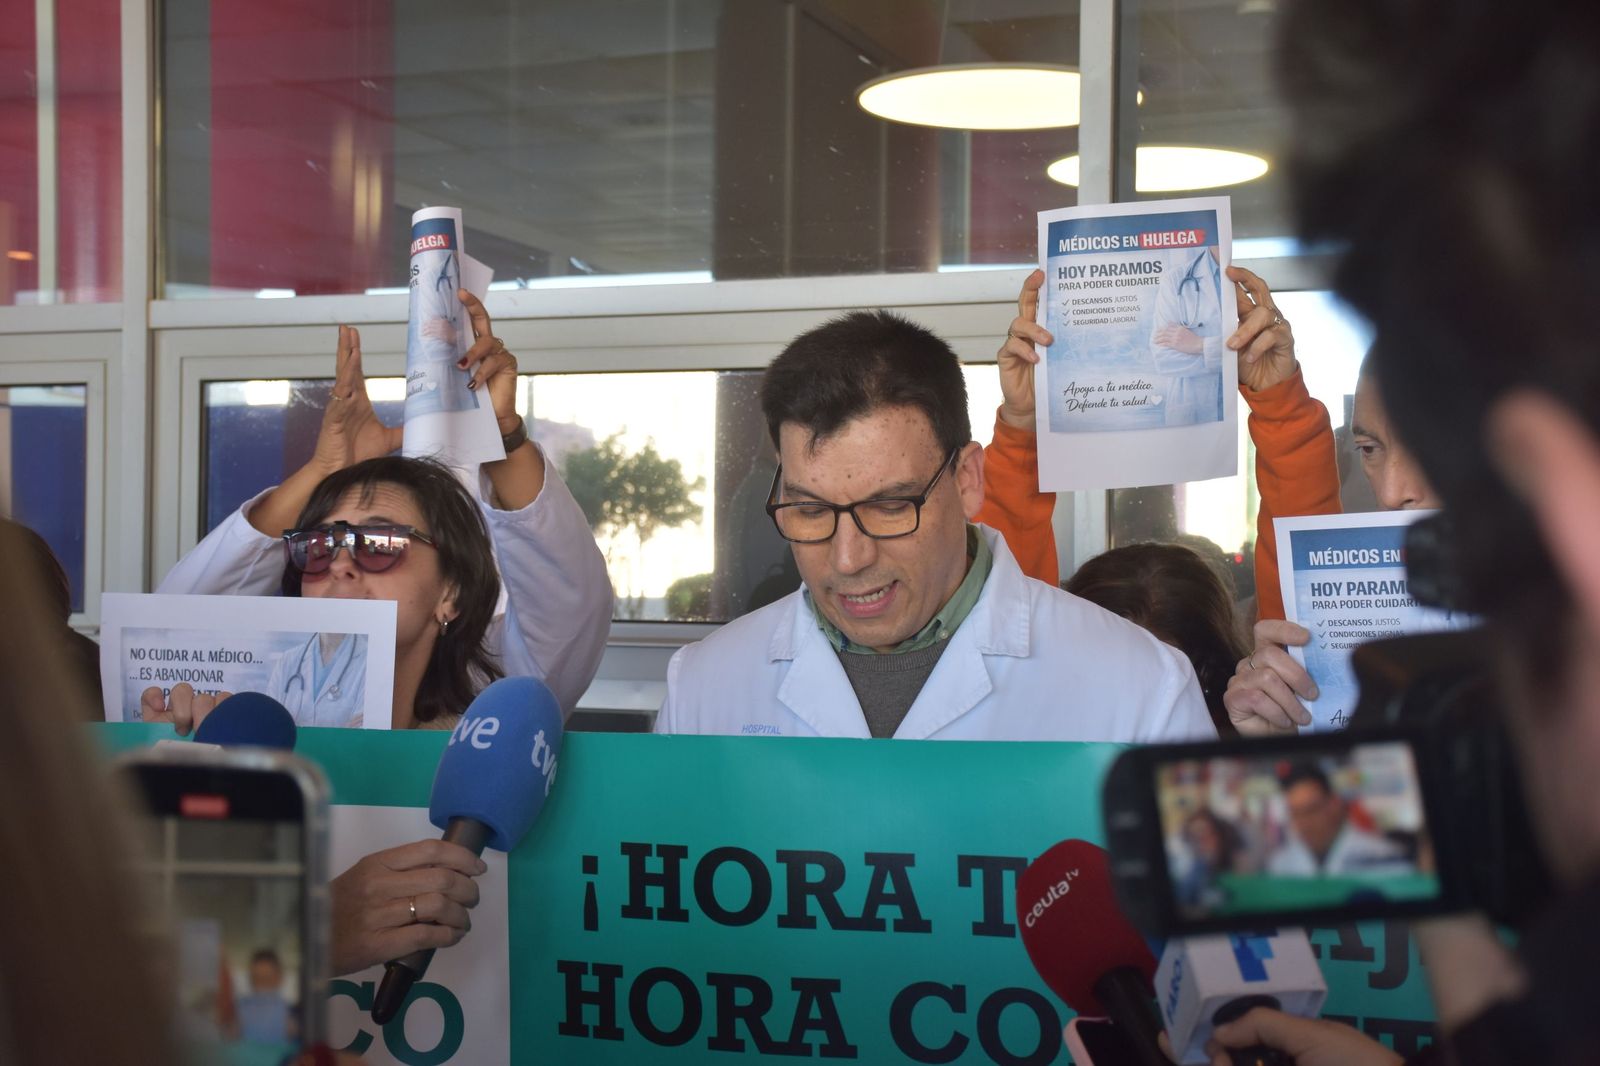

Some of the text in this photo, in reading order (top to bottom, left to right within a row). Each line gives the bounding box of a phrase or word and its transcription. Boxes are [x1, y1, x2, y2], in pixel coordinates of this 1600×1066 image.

[410, 234, 446, 254] UELGA
[1059, 230, 1198, 252] MÉDICOS EN HUELGA
[1058, 261, 1163, 280] HOY PARAMOS
[1058, 276, 1160, 291] PARA PODER CUIDARTE
[1072, 295, 1138, 306] DESCANSOS JUSTOS
[1072, 305, 1141, 316] CONDICIONES DIGNAS
[1072, 316, 1137, 326] SEGURIDAD LABORAL
[1063, 381, 1095, 398] Apoya
[1106, 382, 1116, 393] tu
[1118, 379, 1154, 392] médico.
[1065, 395, 1150, 413] Defiende tu salud.
[1308, 547, 1401, 567] MÉDICOS EN
[1311, 580, 1408, 597] HOY PARAM
[1312, 598, 1420, 610] PARA PODER CUIDART
[1328, 617, 1401, 627] DESCANSOS JUSTOS
[1330, 642, 1361, 650] SEGURID
[130, 648, 264, 664] NO CUIDAR AL MÉDICO...
[154, 668, 224, 683] ABANDONAR
[448, 716, 500, 750] tve
[741, 724, 781, 735] HOSPITAL
[582, 841, 932, 934] ¡HORA
[1025, 880, 1070, 928] ceuta
[557, 959, 858, 1060] HORA
